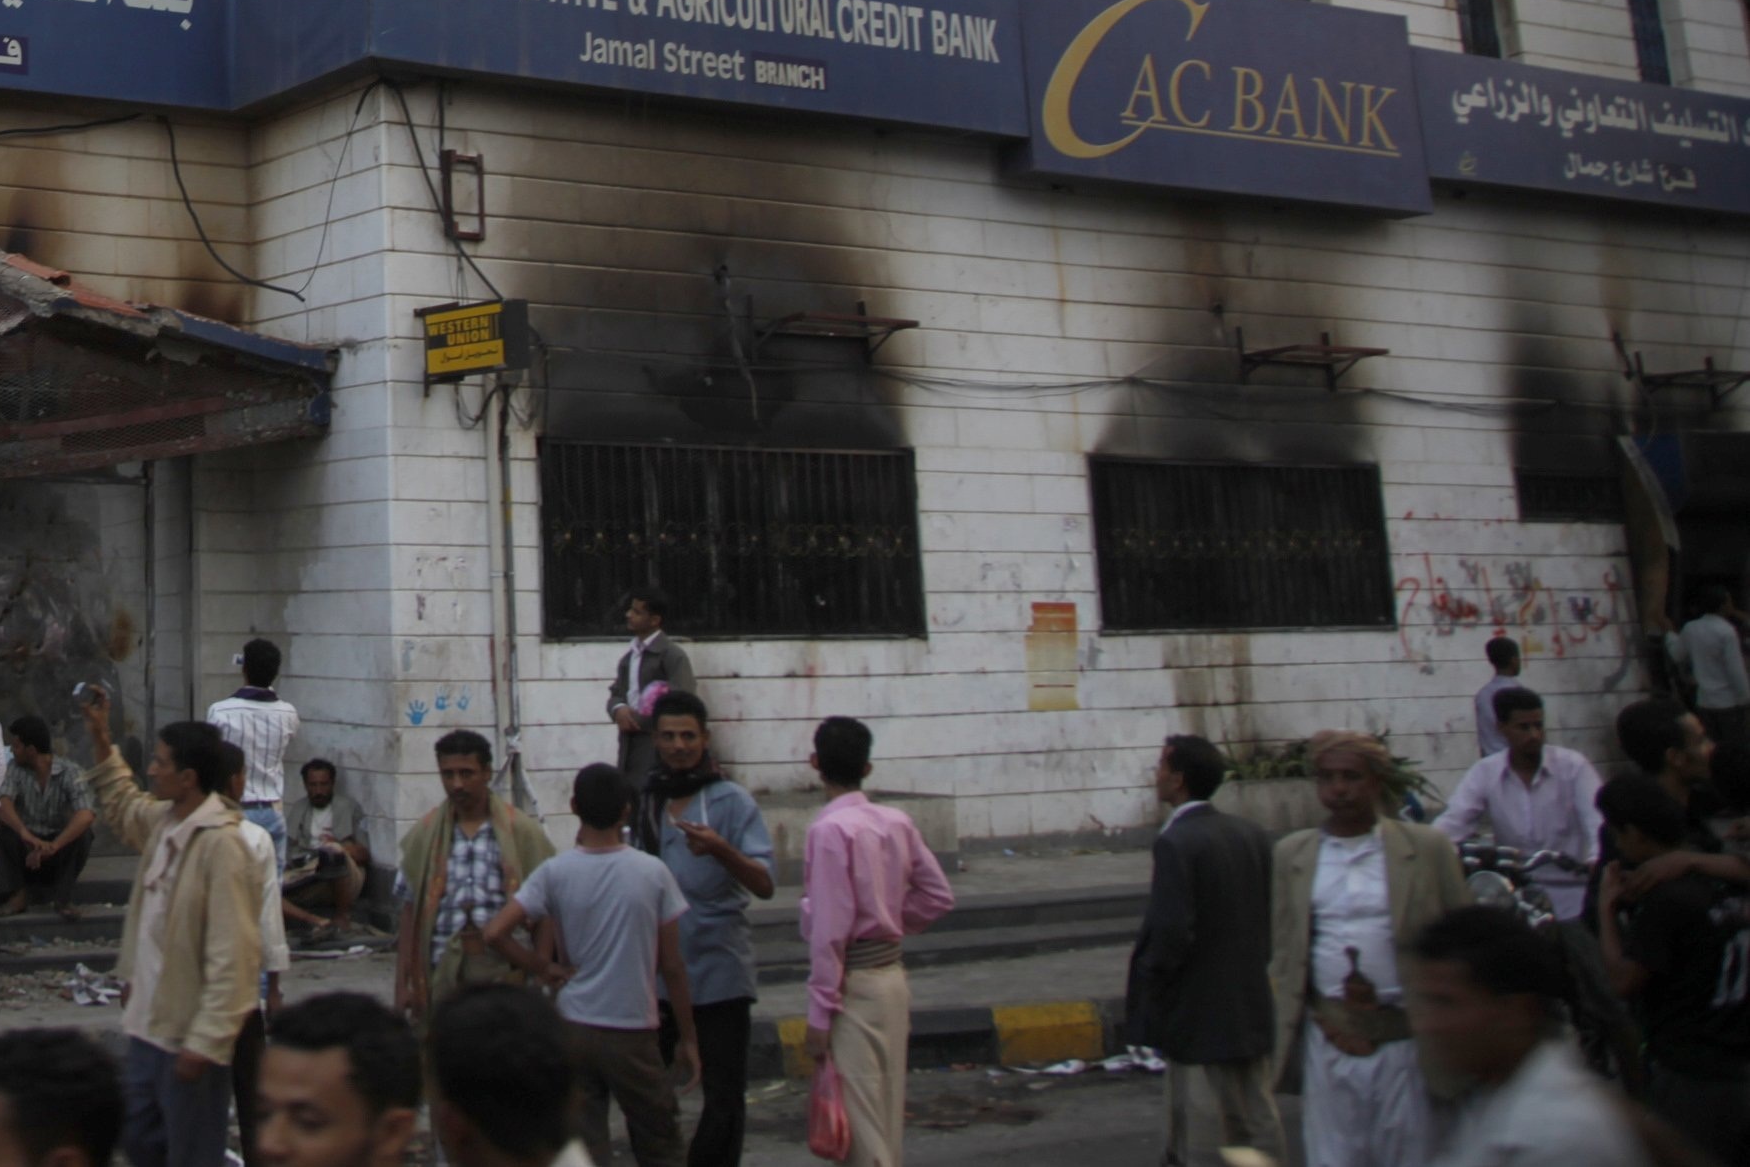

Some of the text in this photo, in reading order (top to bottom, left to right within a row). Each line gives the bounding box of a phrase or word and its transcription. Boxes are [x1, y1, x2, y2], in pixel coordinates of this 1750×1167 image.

[931, 10, 999, 62] BANK
[580, 32, 826, 91] Jamal Street BRANCH
[1228, 66, 1398, 150] BANK
[1452, 77, 1552, 126] والزراعي
[1557, 87, 1646, 137] التعاوني
[1651, 101, 1738, 148] التسليف
[1564, 152, 1609, 181] جمال
[1612, 159, 1654, 187] شارع
[428, 316, 489, 336] WESTERN
[447, 328, 489, 346] UNION
